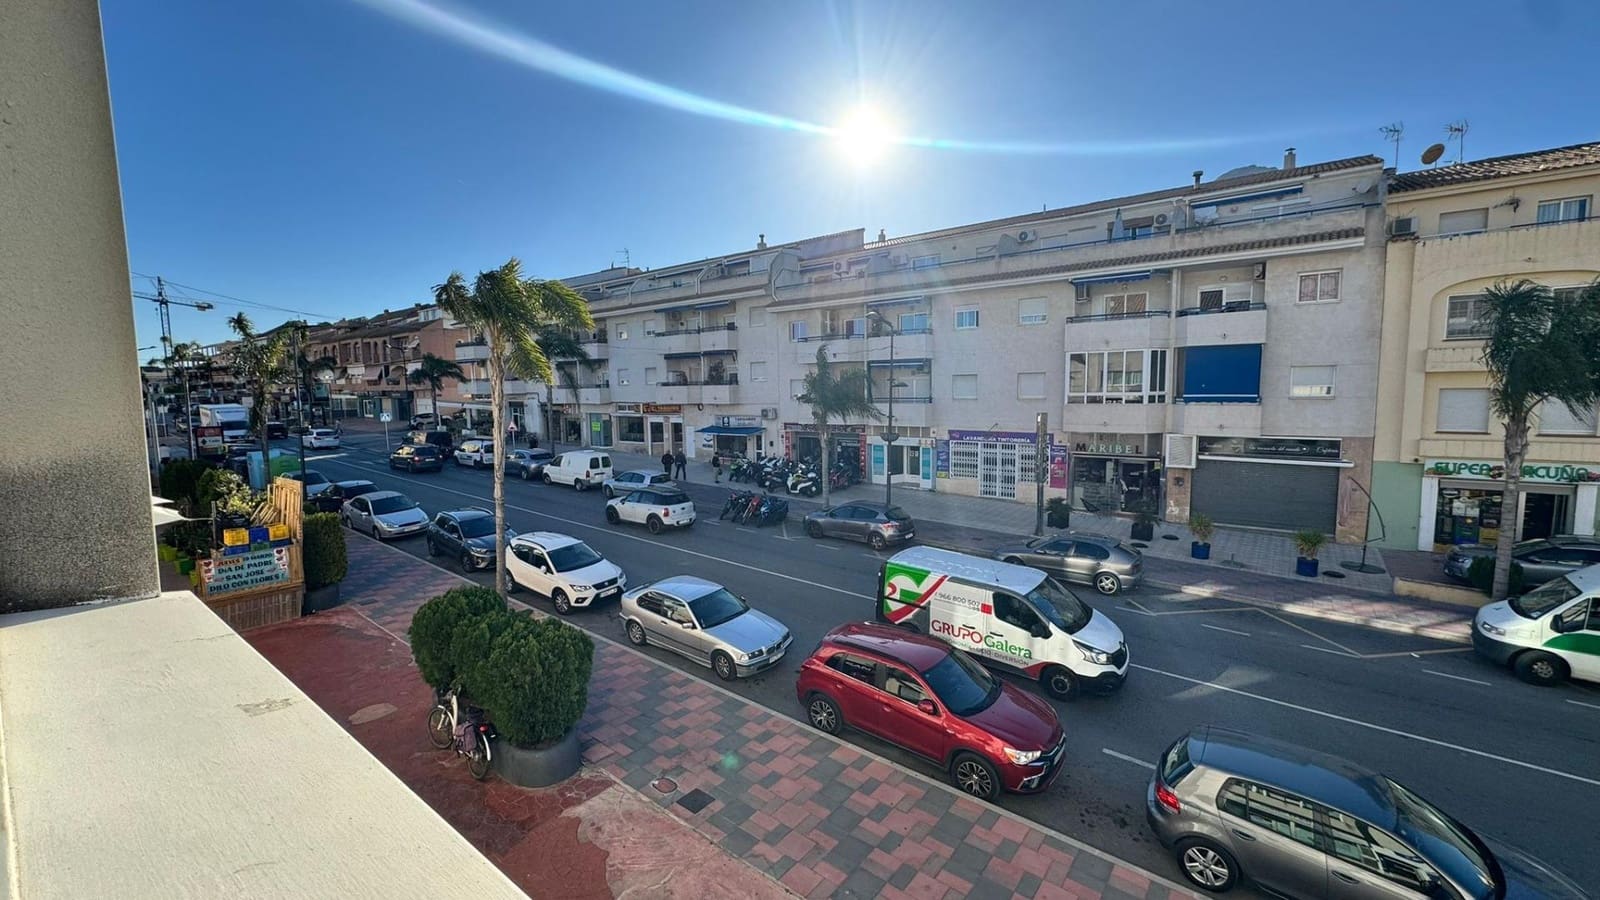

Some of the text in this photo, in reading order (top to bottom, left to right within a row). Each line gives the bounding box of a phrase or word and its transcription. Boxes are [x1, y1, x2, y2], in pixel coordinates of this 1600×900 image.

[1075, 443, 1142, 454] MARIBEL
[247, 560, 273, 569] PADRE
[225, 573, 243, 581] SAN
[231, 580, 249, 588] CON
[931, 619, 982, 644] GRUPO
[984, 634, 1033, 660] Galera
